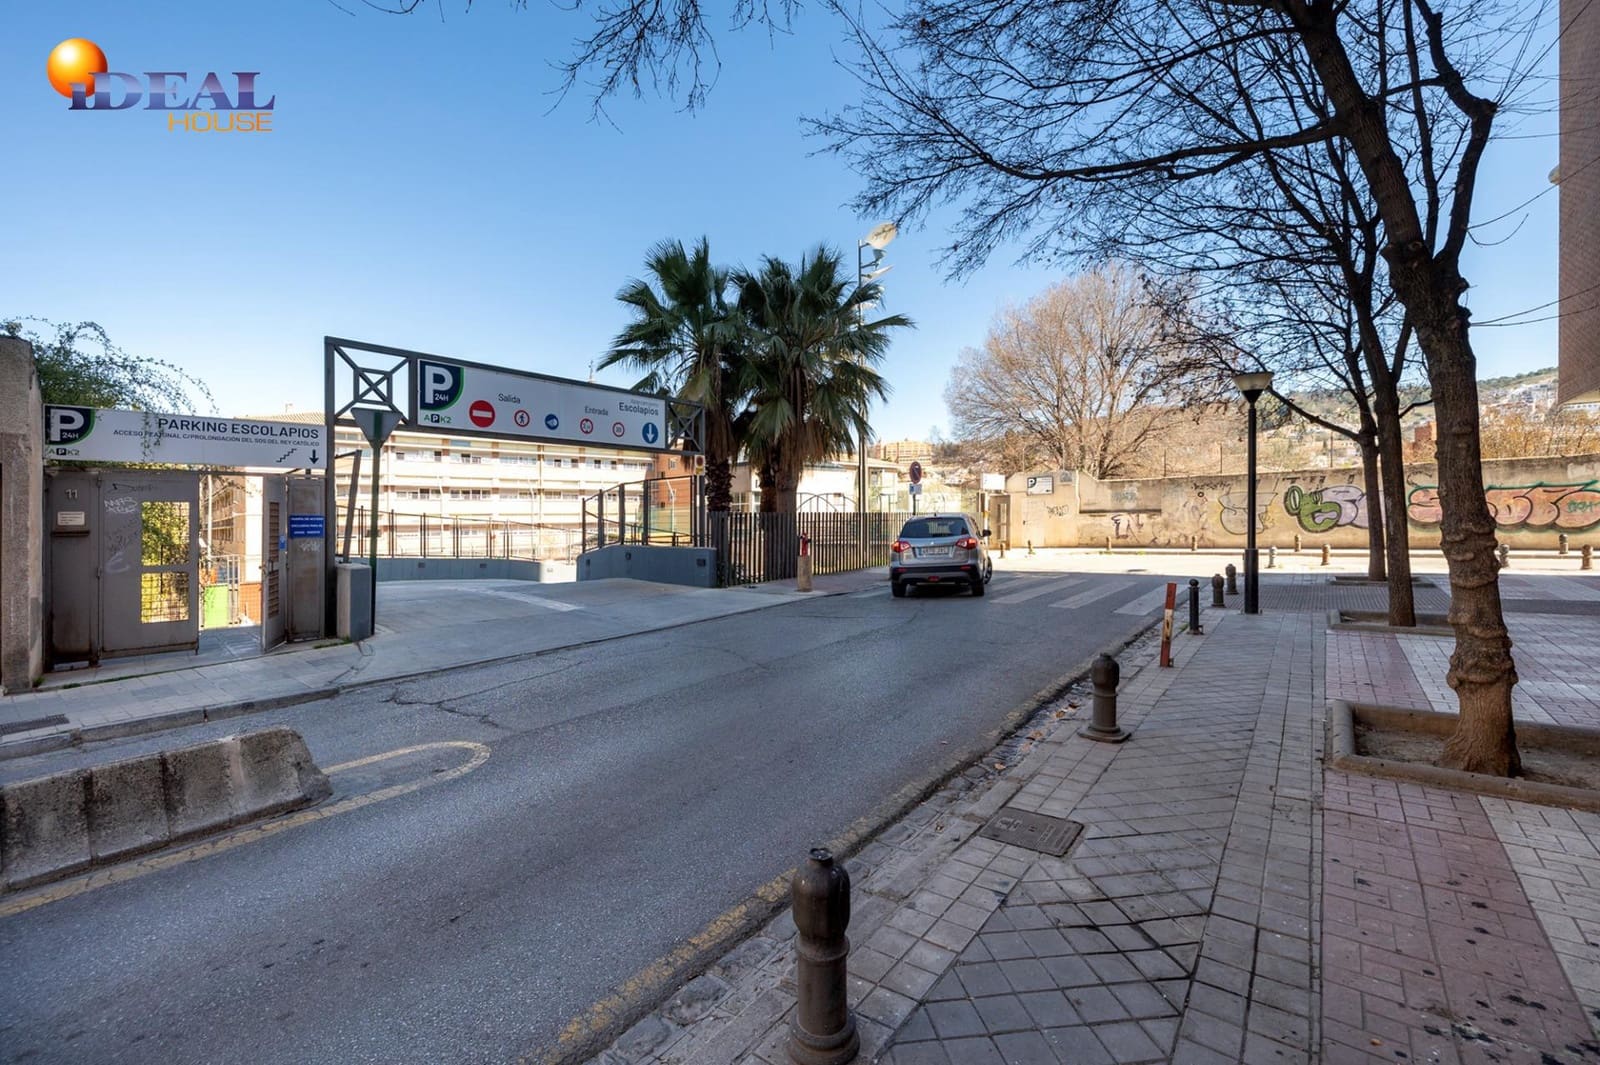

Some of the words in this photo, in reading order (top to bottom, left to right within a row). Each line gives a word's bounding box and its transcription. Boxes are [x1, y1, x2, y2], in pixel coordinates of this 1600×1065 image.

[424, 364, 454, 405] P
[434, 392, 449, 402] 24H
[497, 393, 521, 405] Salida
[584, 405, 609, 416] Entrada
[618, 401, 659, 416] Escolapios
[50, 408, 85, 442] P
[158, 418, 228, 434] PARKING
[231, 423, 320, 439] ESCOLAPIOS
[61, 431, 79, 440] 24H
[113, 429, 143, 437] ACCESO
